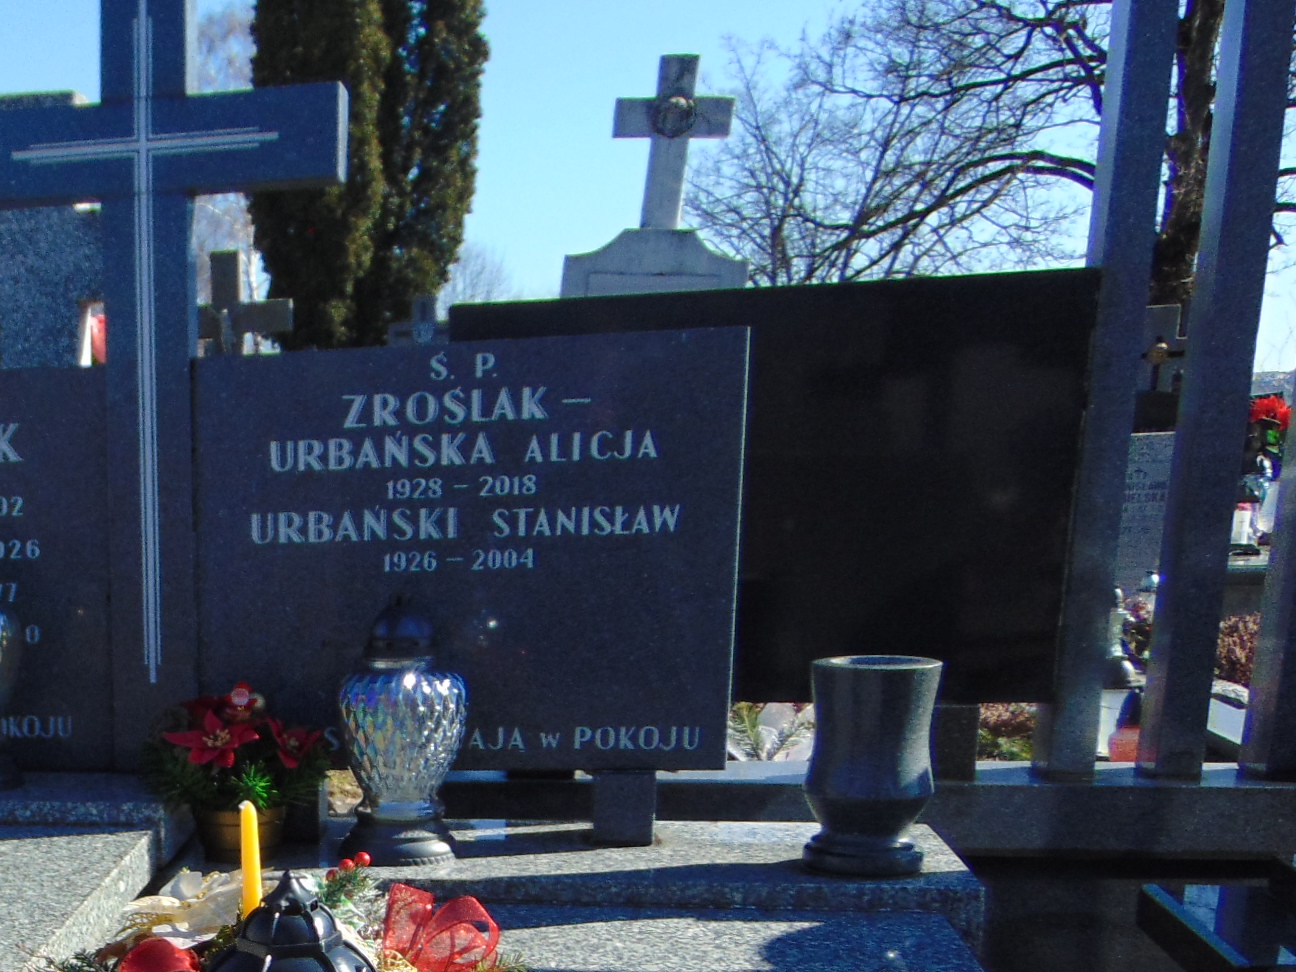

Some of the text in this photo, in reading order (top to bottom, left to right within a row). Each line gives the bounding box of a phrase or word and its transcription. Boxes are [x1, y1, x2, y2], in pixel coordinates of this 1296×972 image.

[475, 352, 497, 380] P.
[342, 385, 549, 429] ZROŚLAK
[270, 429, 659, 473] URBAŃSKA ALICJA
[386, 477, 442, 500] 1928
[478, 474, 537, 498] 2018
[250, 504, 681, 545] URBAŃSKI STANISŁAW
[384, 550, 437, 573] 1926
[470, 547, 535, 571] 2004
[573, 725, 701, 752] POKOJU
